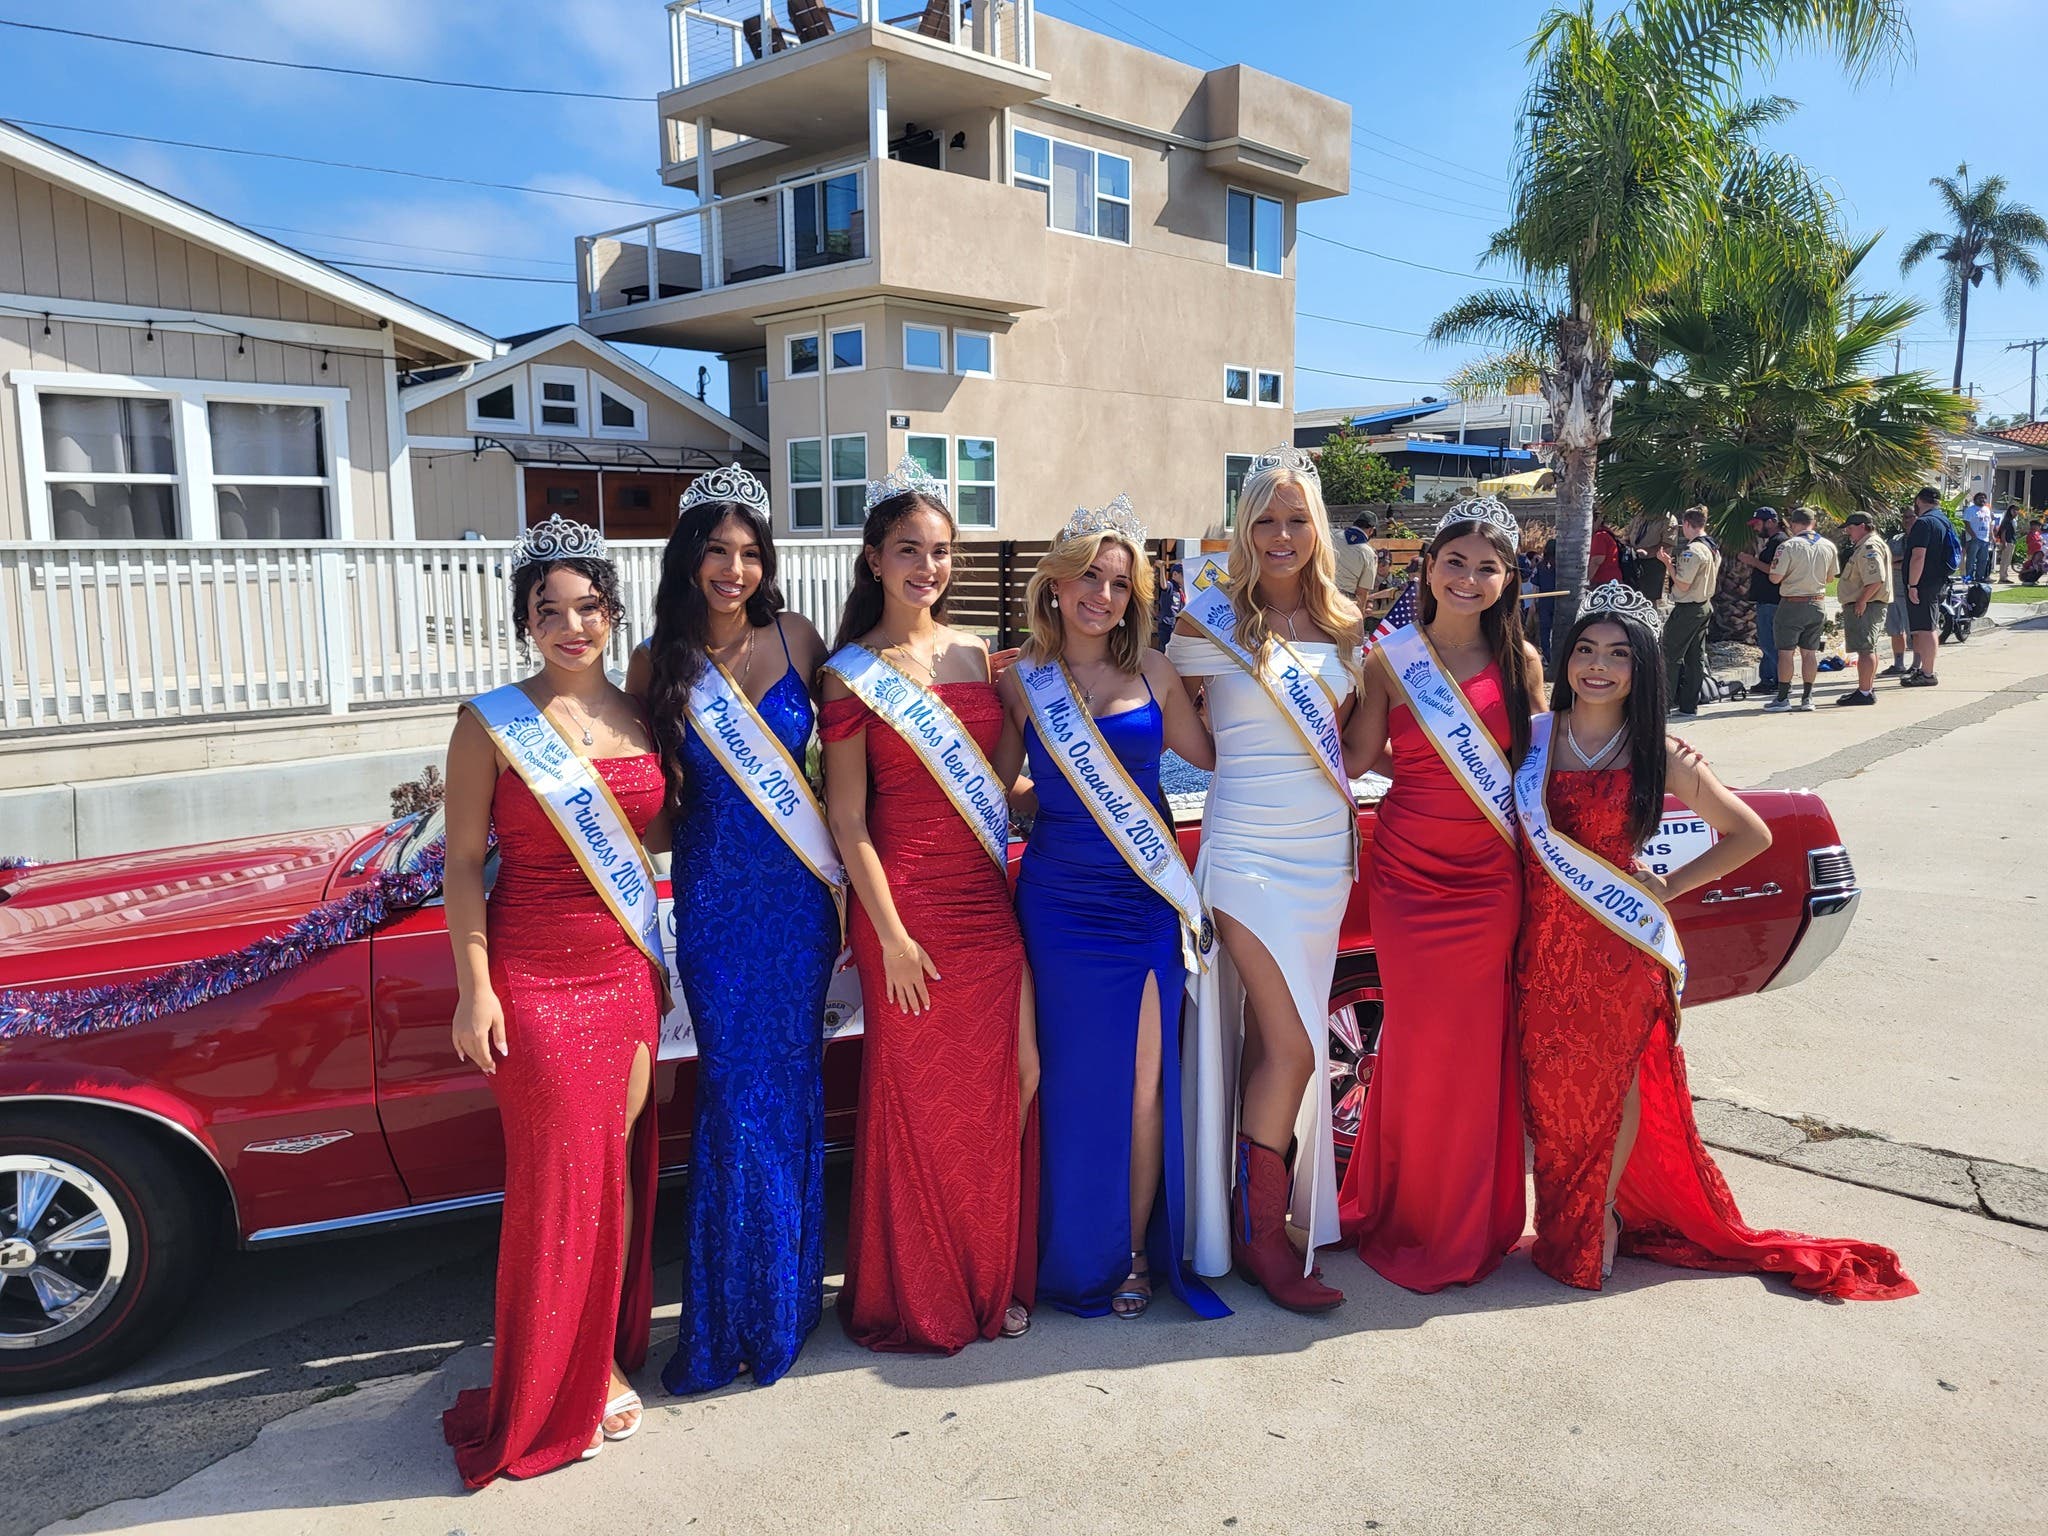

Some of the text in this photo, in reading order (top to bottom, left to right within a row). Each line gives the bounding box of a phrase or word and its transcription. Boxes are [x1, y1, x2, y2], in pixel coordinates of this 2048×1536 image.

[1280, 665, 1340, 768] Princess 2025
[1417, 689, 1455, 718] Oceanside
[1433, 684, 1454, 703] Miss
[524, 750, 564, 781] Oceanside
[541, 749, 560, 766] Teen
[545, 740, 568, 760] Miss
[703, 695, 801, 817] Princess 2025
[903, 699, 944, 748] Miss
[941, 739, 970, 783] Teen
[1448, 722, 1497, 792] Princess
[1044, 696, 1166, 862] Miss Oceanside 2025
[564, 787, 645, 907] Princess 2025
[1656, 821, 1706, 836] IDE
[1533, 825, 1643, 924] Princess 2025
[1703, 882, 1782, 903] GTO
